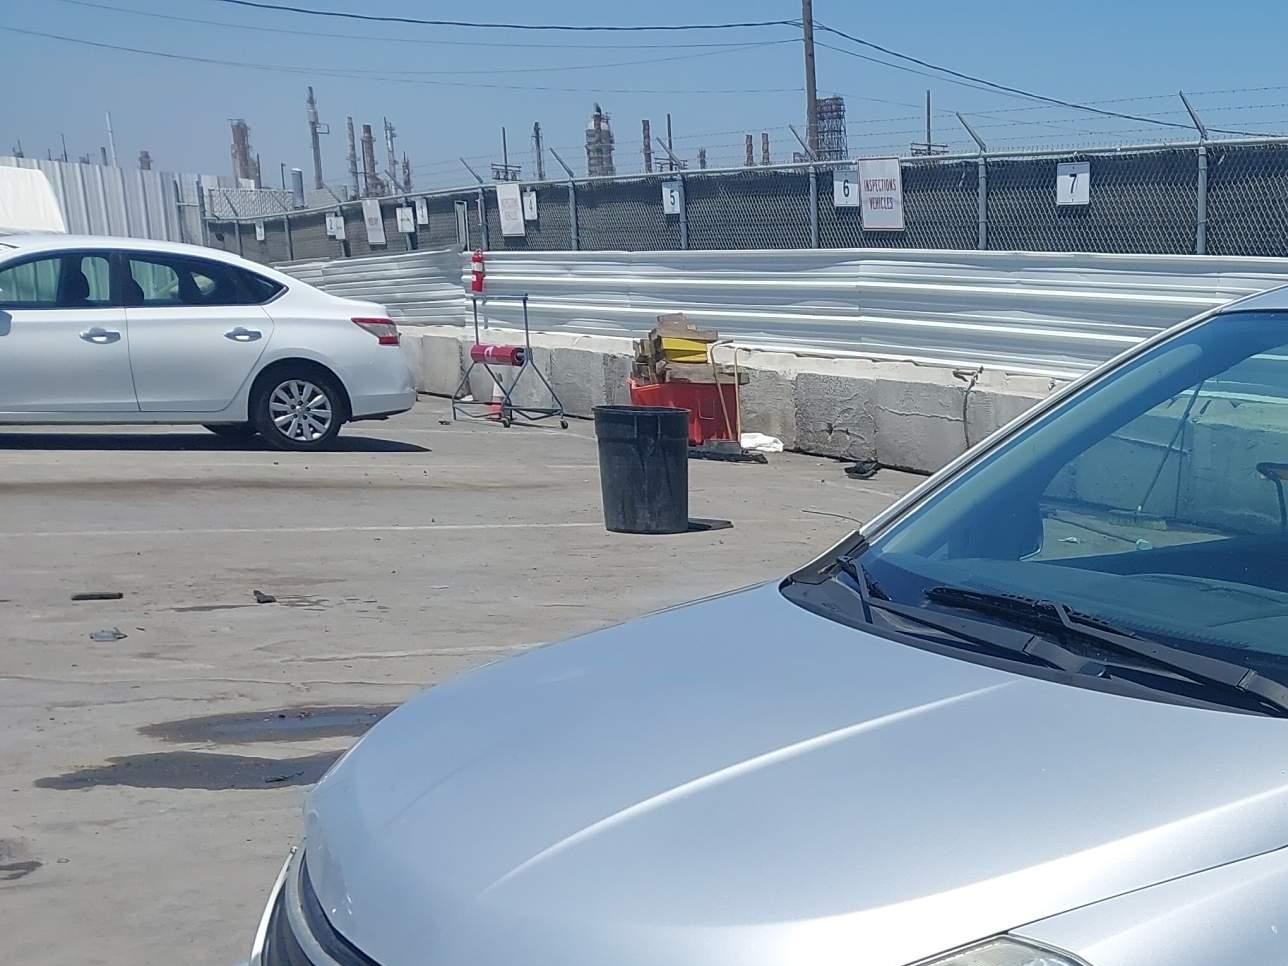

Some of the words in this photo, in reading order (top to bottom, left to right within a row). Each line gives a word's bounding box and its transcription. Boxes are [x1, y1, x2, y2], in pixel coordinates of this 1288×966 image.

[842, 179, 850, 198] 6
[863, 178, 897, 193] INSPECTIONS
[1069, 173, 1078, 194] 7
[669, 189, 676, 206] 5
[868, 196, 894, 211] VEHICLES
